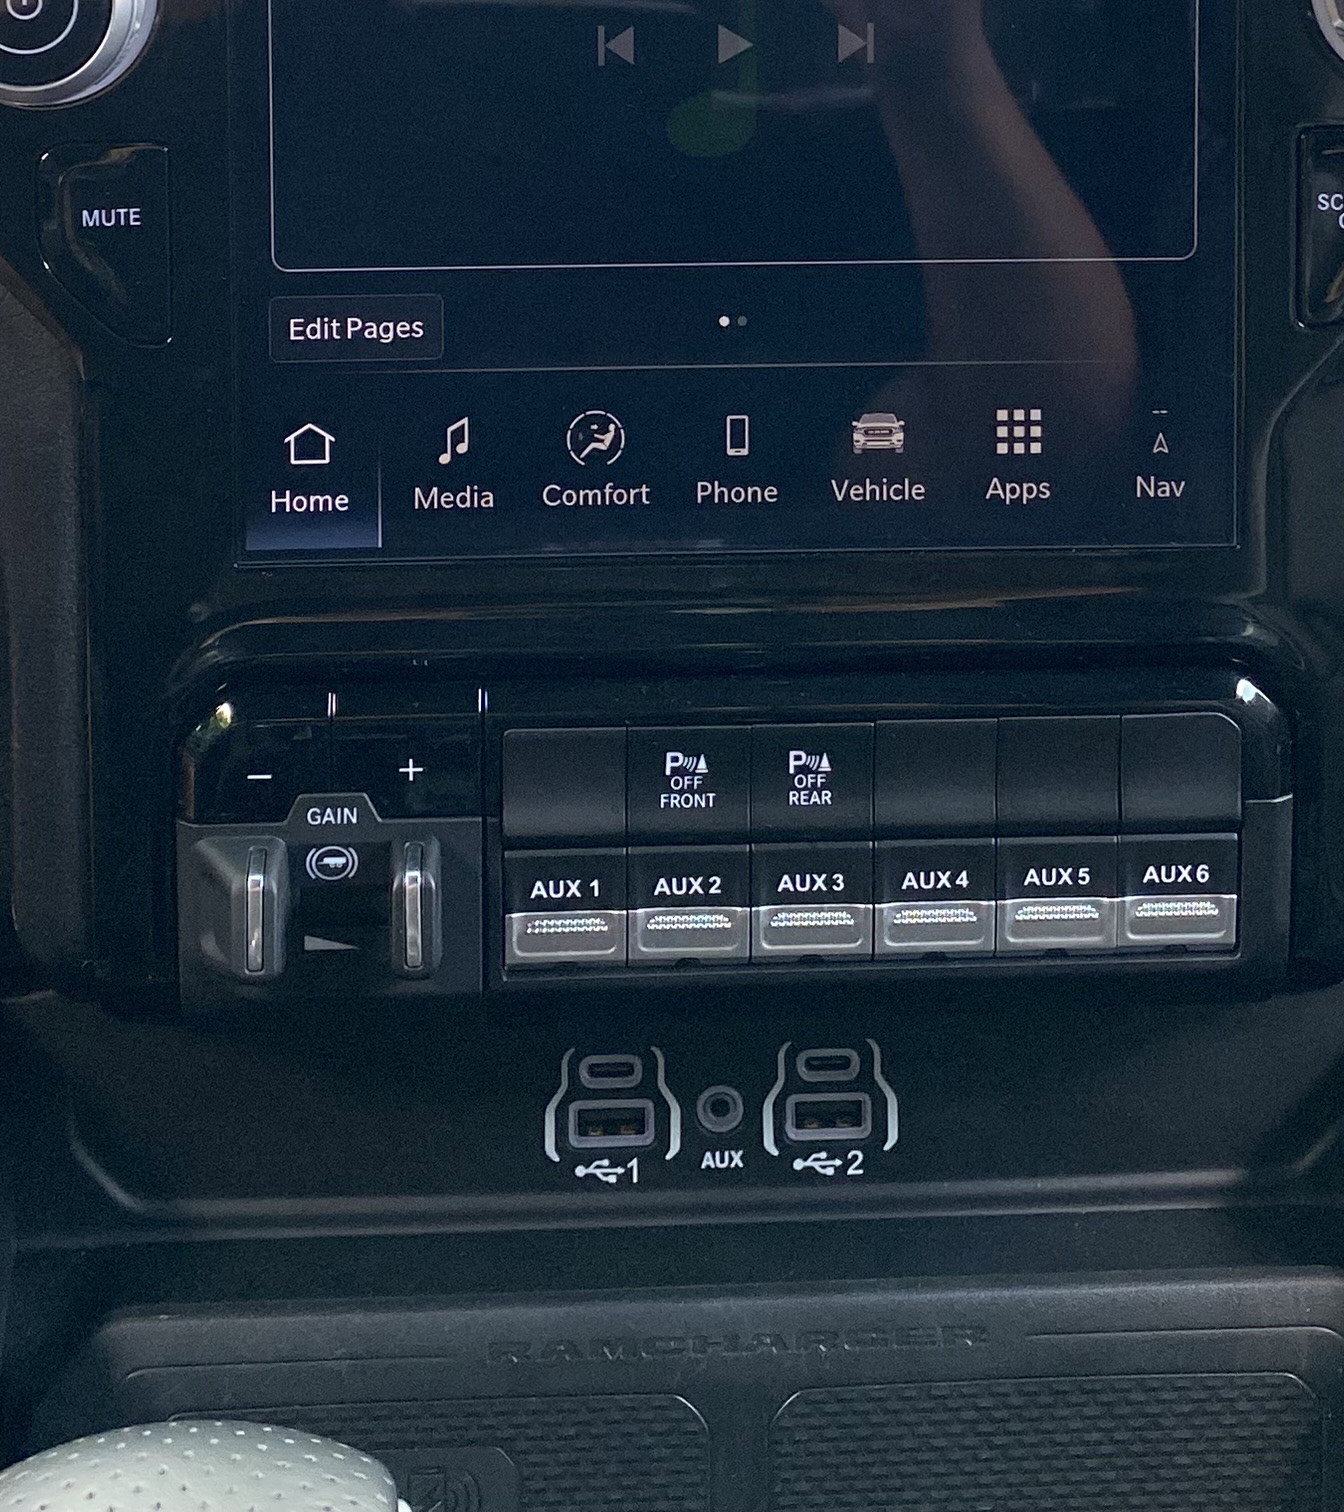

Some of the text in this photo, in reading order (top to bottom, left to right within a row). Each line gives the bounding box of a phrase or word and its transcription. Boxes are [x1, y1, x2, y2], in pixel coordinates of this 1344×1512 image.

[82, 207, 141, 227] MUTE
[289, 317, 424, 344] Edit Pages
[542, 482, 650, 507] Comfort
[697, 480, 778, 504] Phone
[831, 477, 926, 502] Vehicle
[985, 477, 1051, 505] Apps
[1136, 475, 1186, 498] Nav
[271, 490, 349, 513] Home
[414, 485, 494, 510] Media
[670, 775, 704, 790] OFF
[794, 773, 827, 789] OFF
[659, 792, 717, 809] FRONT
[788, 790, 833, 806] REAR
[306, 807, 357, 825] GAIN
[777, 873, 845, 892] AUX 3
[901, 870, 969, 890] AUX 4
[1023, 867, 1090, 886] AUX 5
[1142, 864, 1210, 884] AUX 6
[530, 879, 599, 899] AUX 1
[653, 876, 722, 896] AUX 2
[701, 1150, 744, 1169] AUX
[846, 1150, 864, 1176] 2
[624, 1157, 640, 1184] 1
[487, 1324, 990, 1364] RAMCHARGER
